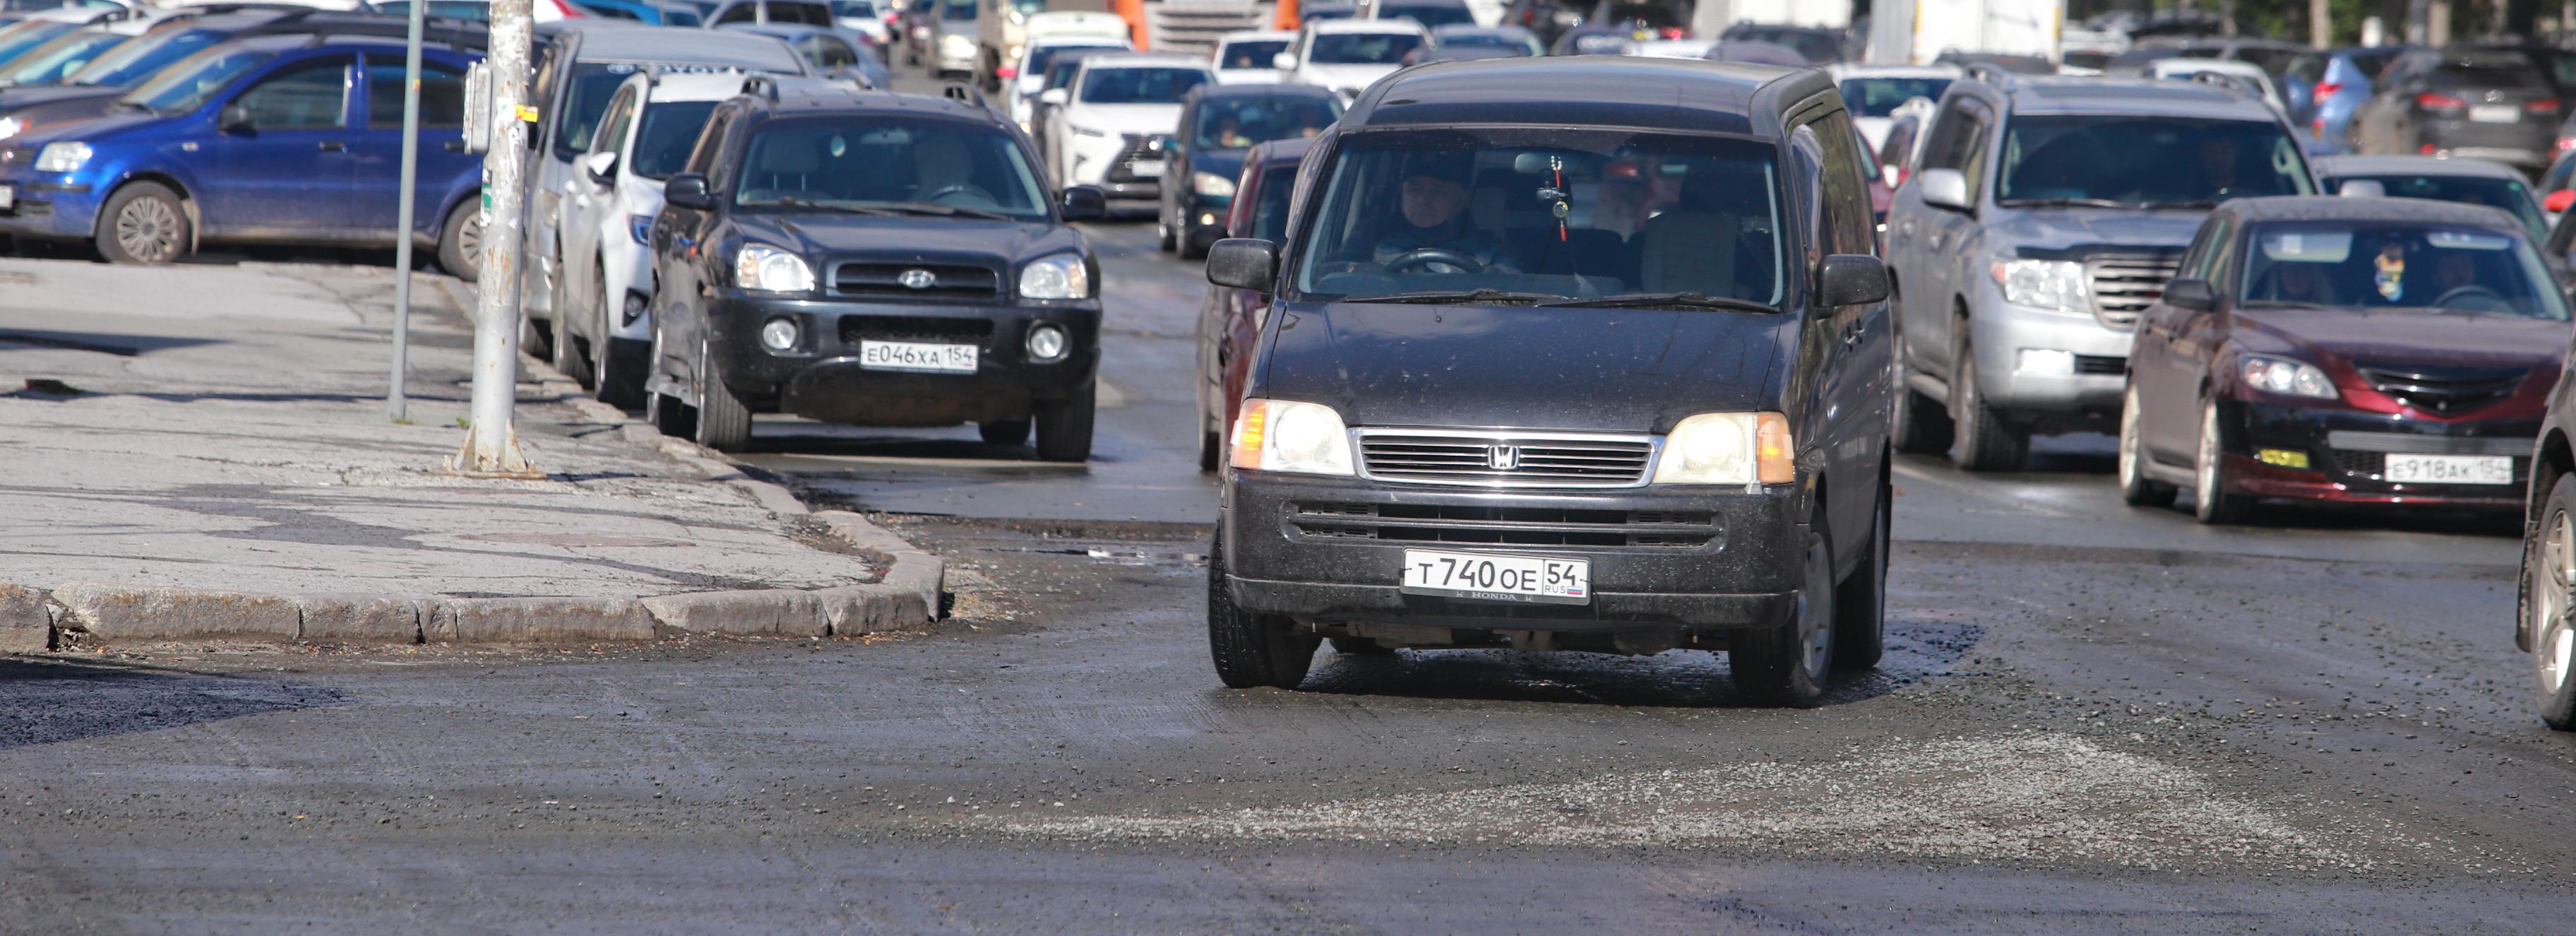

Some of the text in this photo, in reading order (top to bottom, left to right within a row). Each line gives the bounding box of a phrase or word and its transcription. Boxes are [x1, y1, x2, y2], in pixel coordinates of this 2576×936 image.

[868, 345, 972, 365] Е046ХА 154
[1418, 557, 1575, 591] Т740ОЕ 54
[1471, 591, 1517, 600] HONDA
[1545, 585, 1566, 594] RUS
